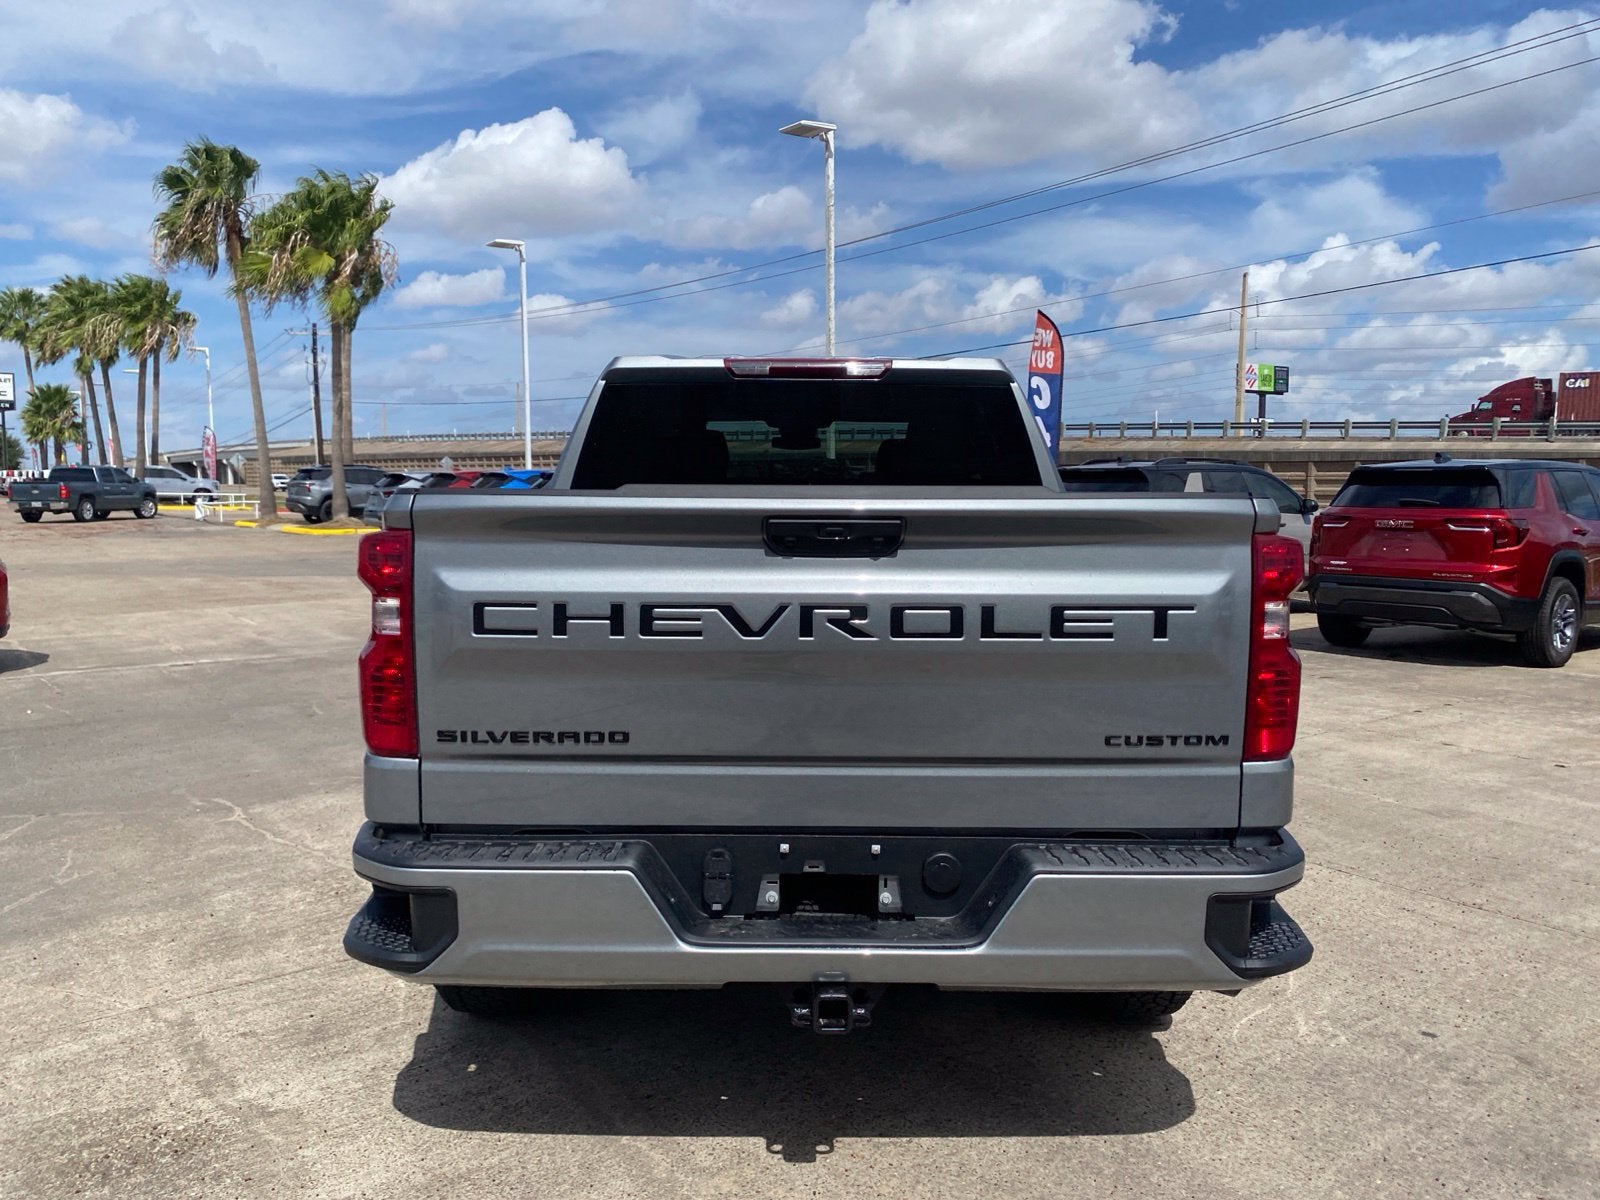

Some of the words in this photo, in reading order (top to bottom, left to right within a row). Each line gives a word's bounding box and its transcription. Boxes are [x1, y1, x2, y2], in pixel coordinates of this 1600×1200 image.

[1565, 378, 1590, 388] CAI
[1375, 519, 1415, 528] GMC
[472, 602, 1196, 641] CHEVROLET
[437, 729, 630, 744] SILVERADO
[1104, 735, 1229, 747] CUSTOM
